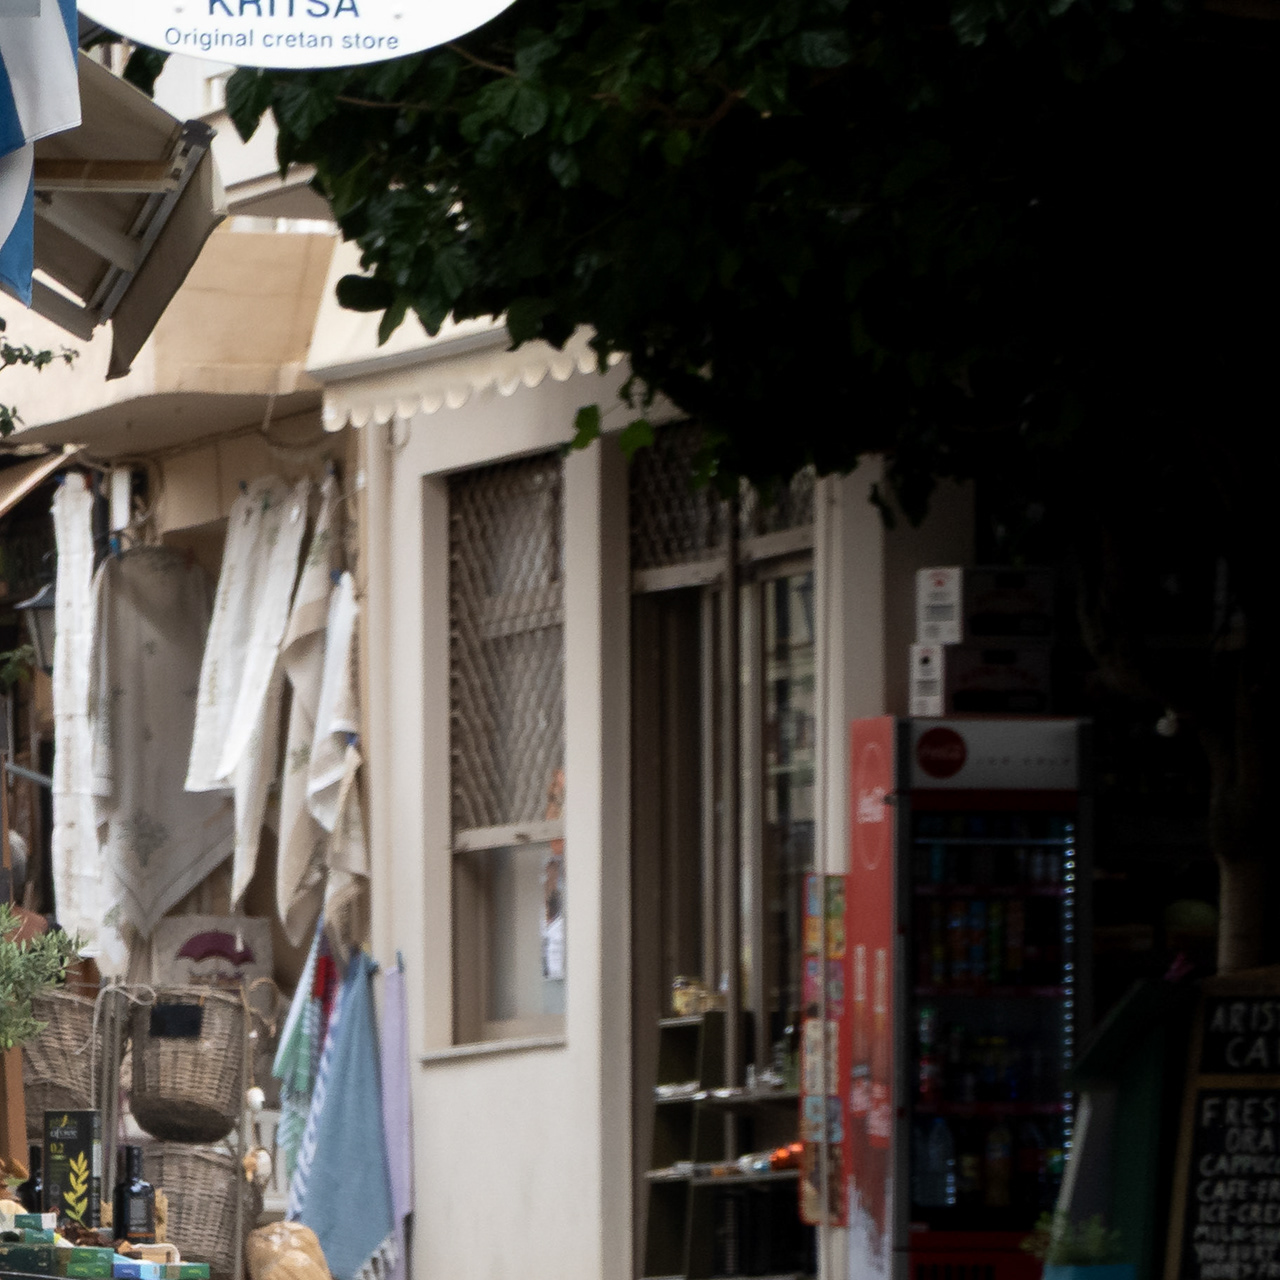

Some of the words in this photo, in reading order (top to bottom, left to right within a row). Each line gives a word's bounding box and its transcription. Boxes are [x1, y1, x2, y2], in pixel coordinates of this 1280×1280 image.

[208, 0, 360, 19] KRITSA
[164, 27, 254, 52] Original
[261, 30, 333, 49] cretan
[341, 33, 400, 50] store
[1225, 1034, 1280, 1069] CA
